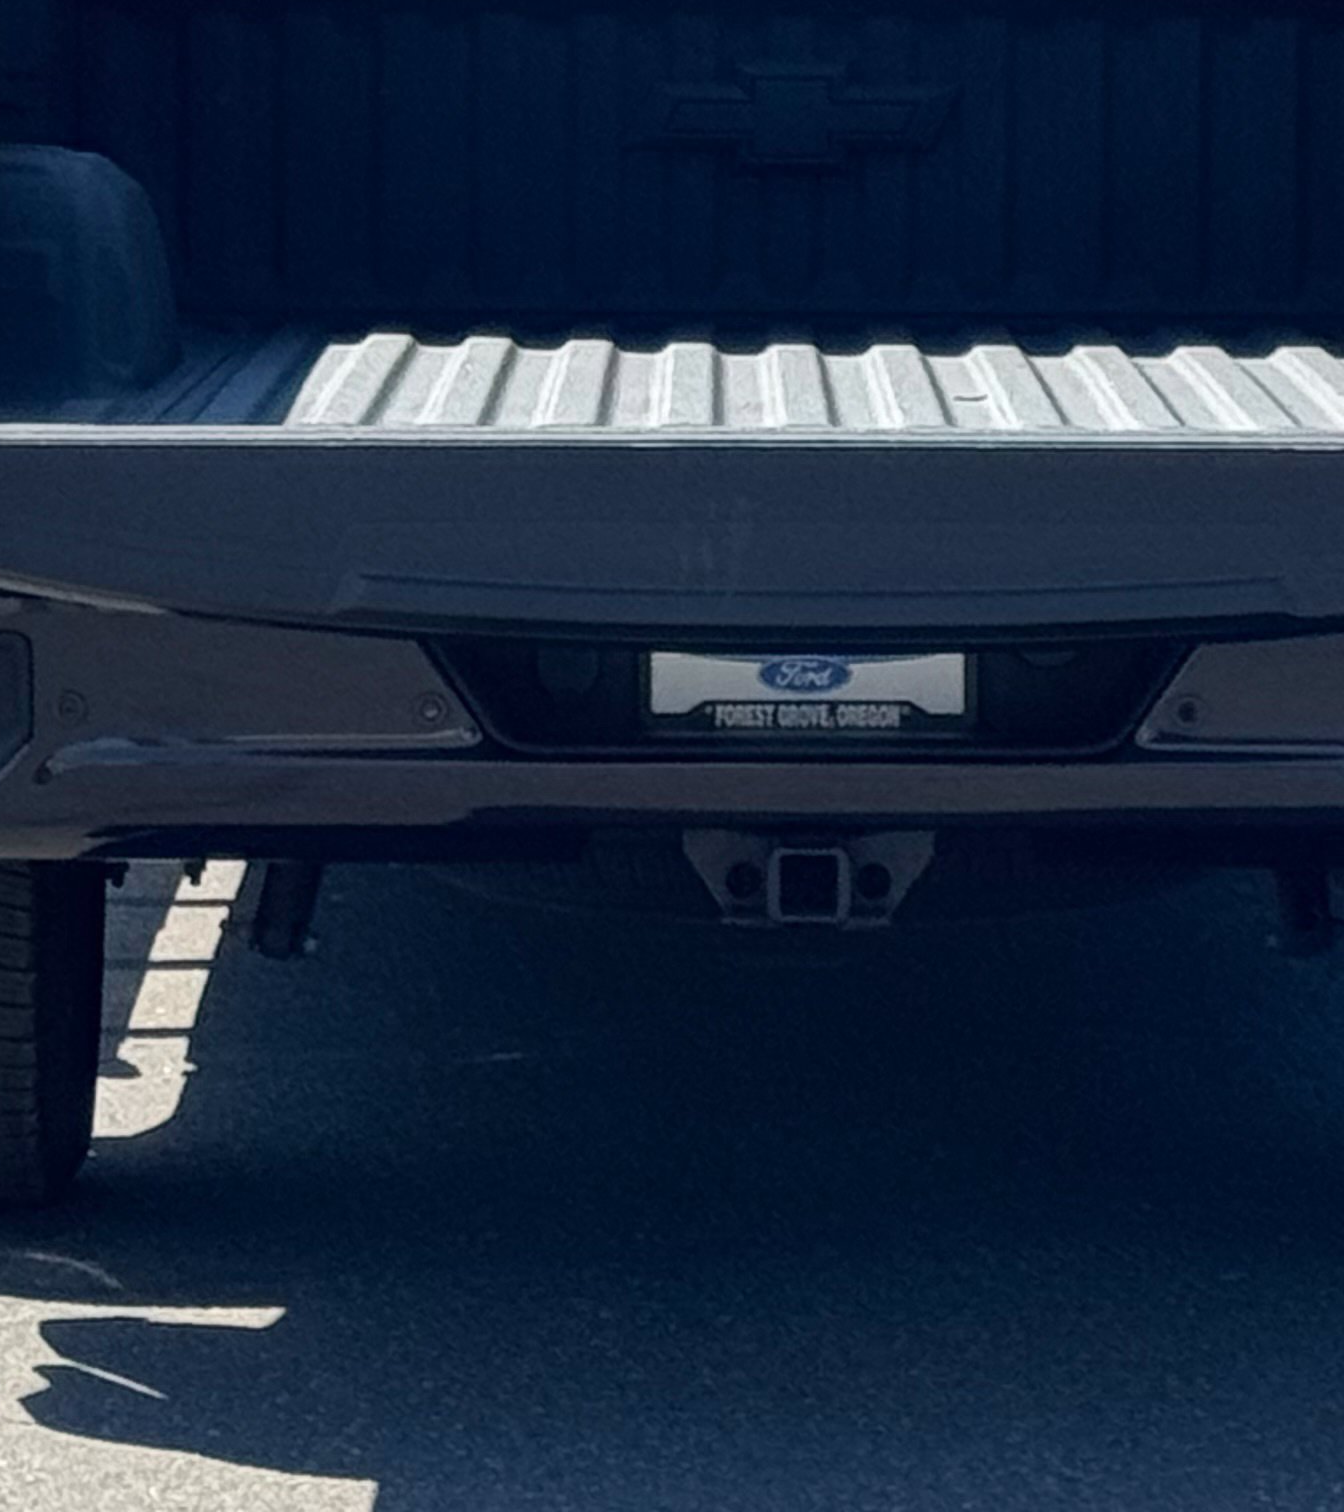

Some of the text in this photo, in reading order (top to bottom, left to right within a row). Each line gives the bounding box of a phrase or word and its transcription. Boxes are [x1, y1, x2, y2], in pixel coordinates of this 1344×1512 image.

[776, 661, 834, 687] Ford
[714, 704, 774, 727] FOREST
[836, 704, 900, 728] OREGON
